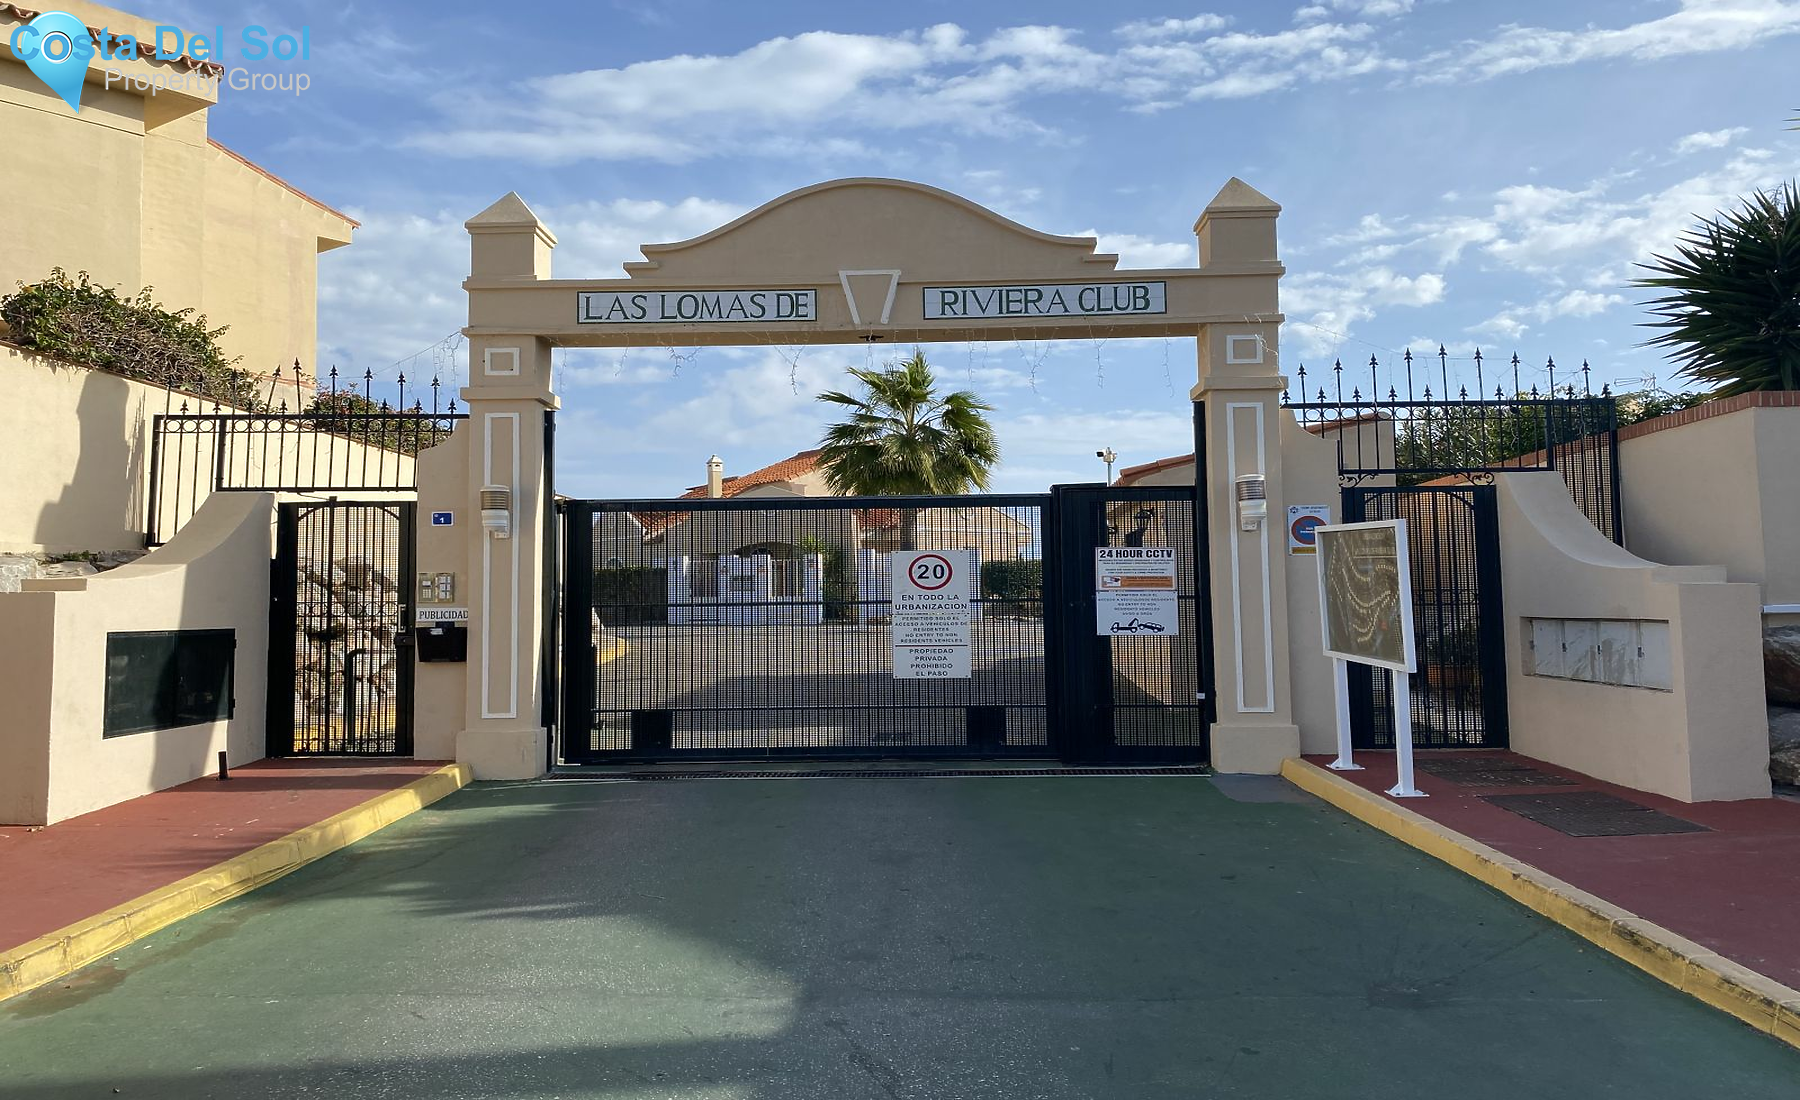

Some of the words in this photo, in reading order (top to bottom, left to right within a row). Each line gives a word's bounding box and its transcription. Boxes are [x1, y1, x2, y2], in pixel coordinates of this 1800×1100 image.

[583, 294, 648, 320] LAS
[659, 292, 767, 320] LOMAS
[774, 291, 809, 319] DE
[939, 288, 1071, 316] RIVIERA
[1078, 285, 1151, 313] CLUB
[1099, 549, 1113, 558] 24
[1115, 549, 1143, 558] HOUR
[1145, 549, 1173, 558] CCTV
[917, 564, 945, 579] 20
[419, 610, 468, 620] PUBLICIDAD
